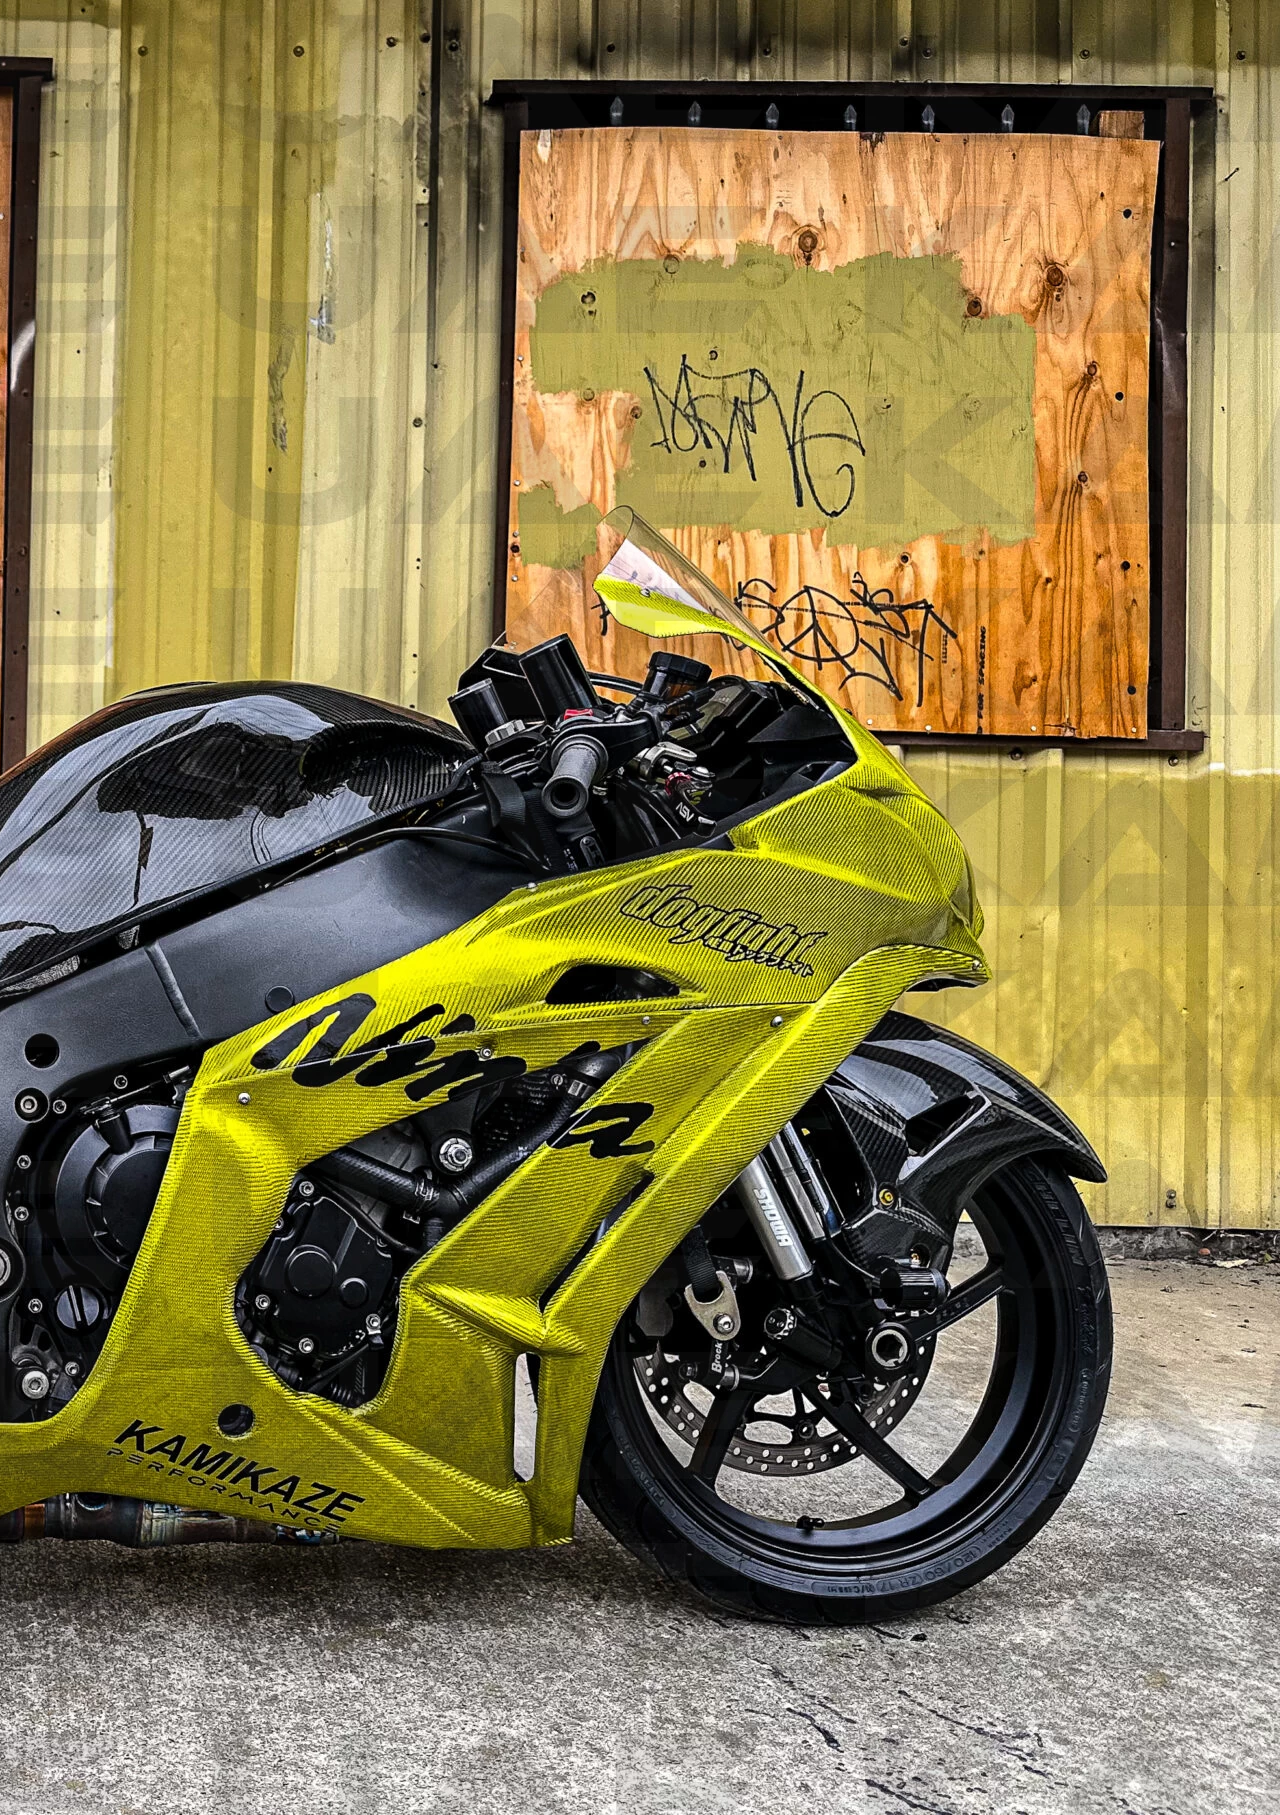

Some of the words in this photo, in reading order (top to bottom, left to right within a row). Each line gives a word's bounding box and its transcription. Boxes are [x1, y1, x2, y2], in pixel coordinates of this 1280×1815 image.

[978, 625, 987, 685] SPACING
[620, 884, 828, 962] dogfight
[752, 1185, 793, 1248] SHOWA
[106, 1447, 342, 1534] PERFORMANCE
[114, 1419, 366, 1522] KAMIKAZE
